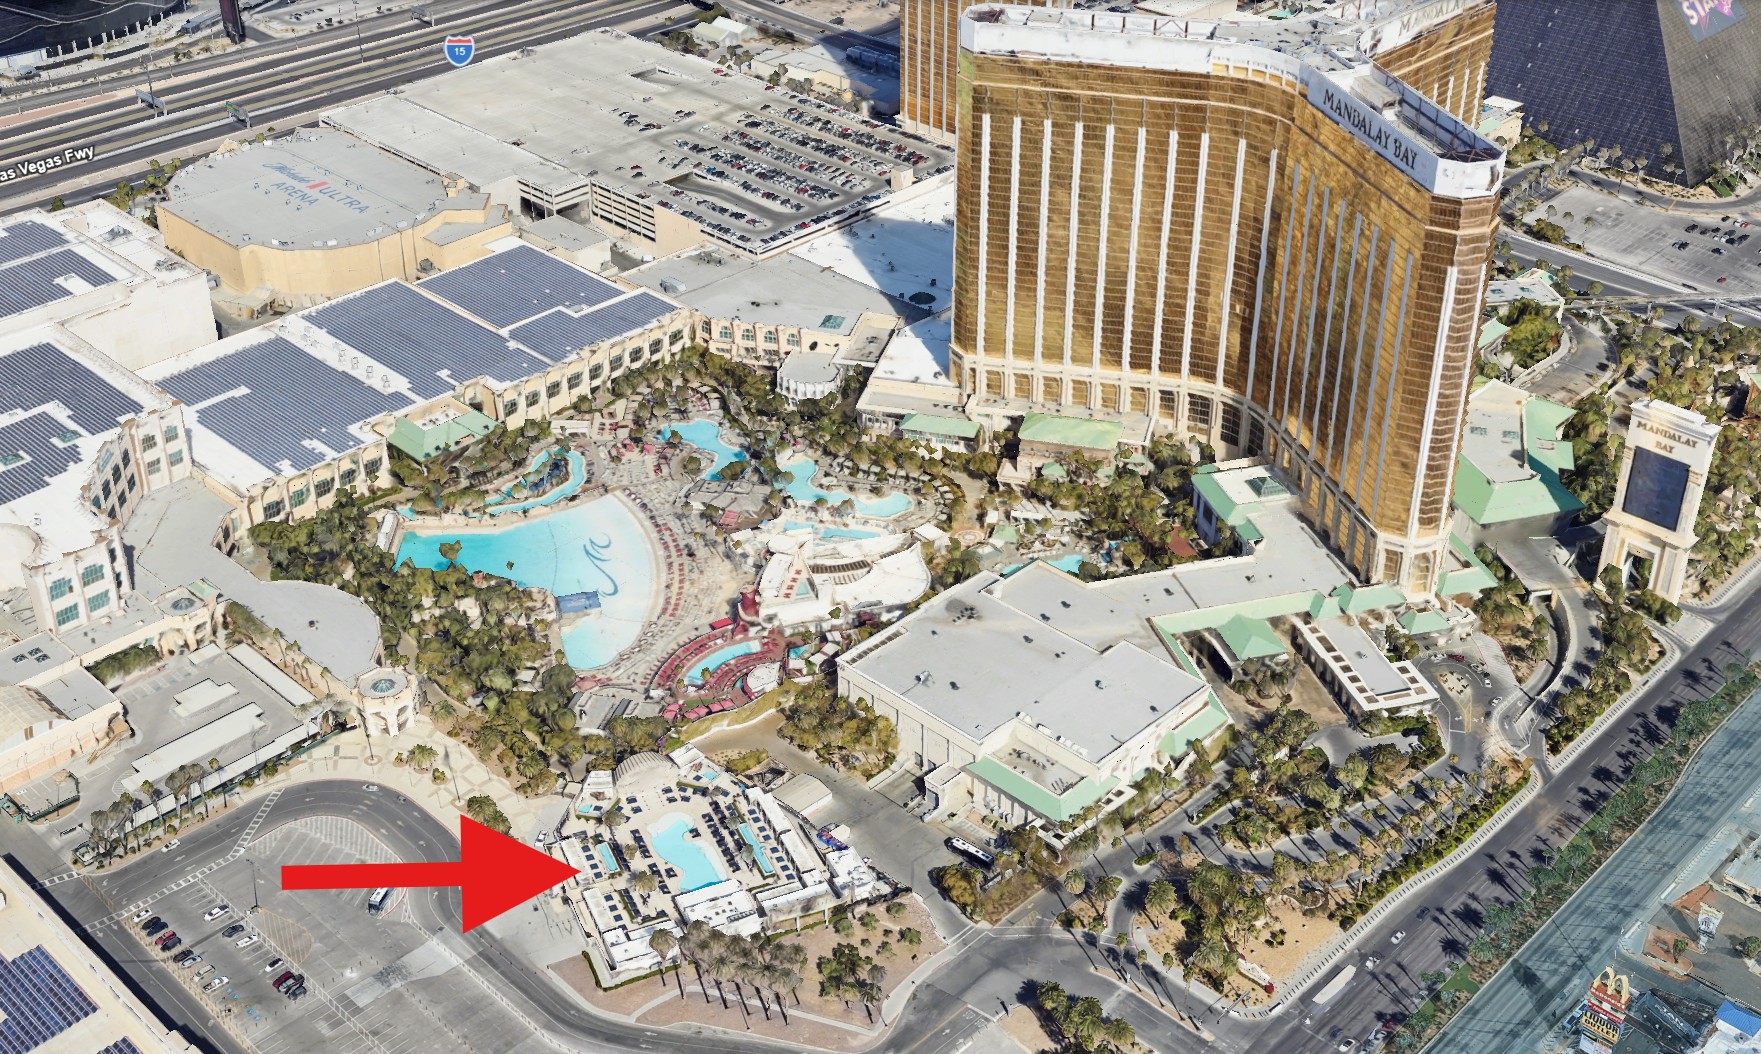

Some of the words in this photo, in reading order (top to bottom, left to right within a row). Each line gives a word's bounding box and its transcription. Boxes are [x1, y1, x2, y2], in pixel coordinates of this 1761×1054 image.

[1323, 88, 1391, 150] MANDALAY
[1393, 138, 1418, 170] BAY
[270, 181, 320, 206] ARENA
[319, 187, 370, 213] ULTRA
[1636, 420, 1698, 449] MANDALAY
[1655, 440, 1675, 454] BAY
[1584, 1018, 1617, 1038] OUTLET
